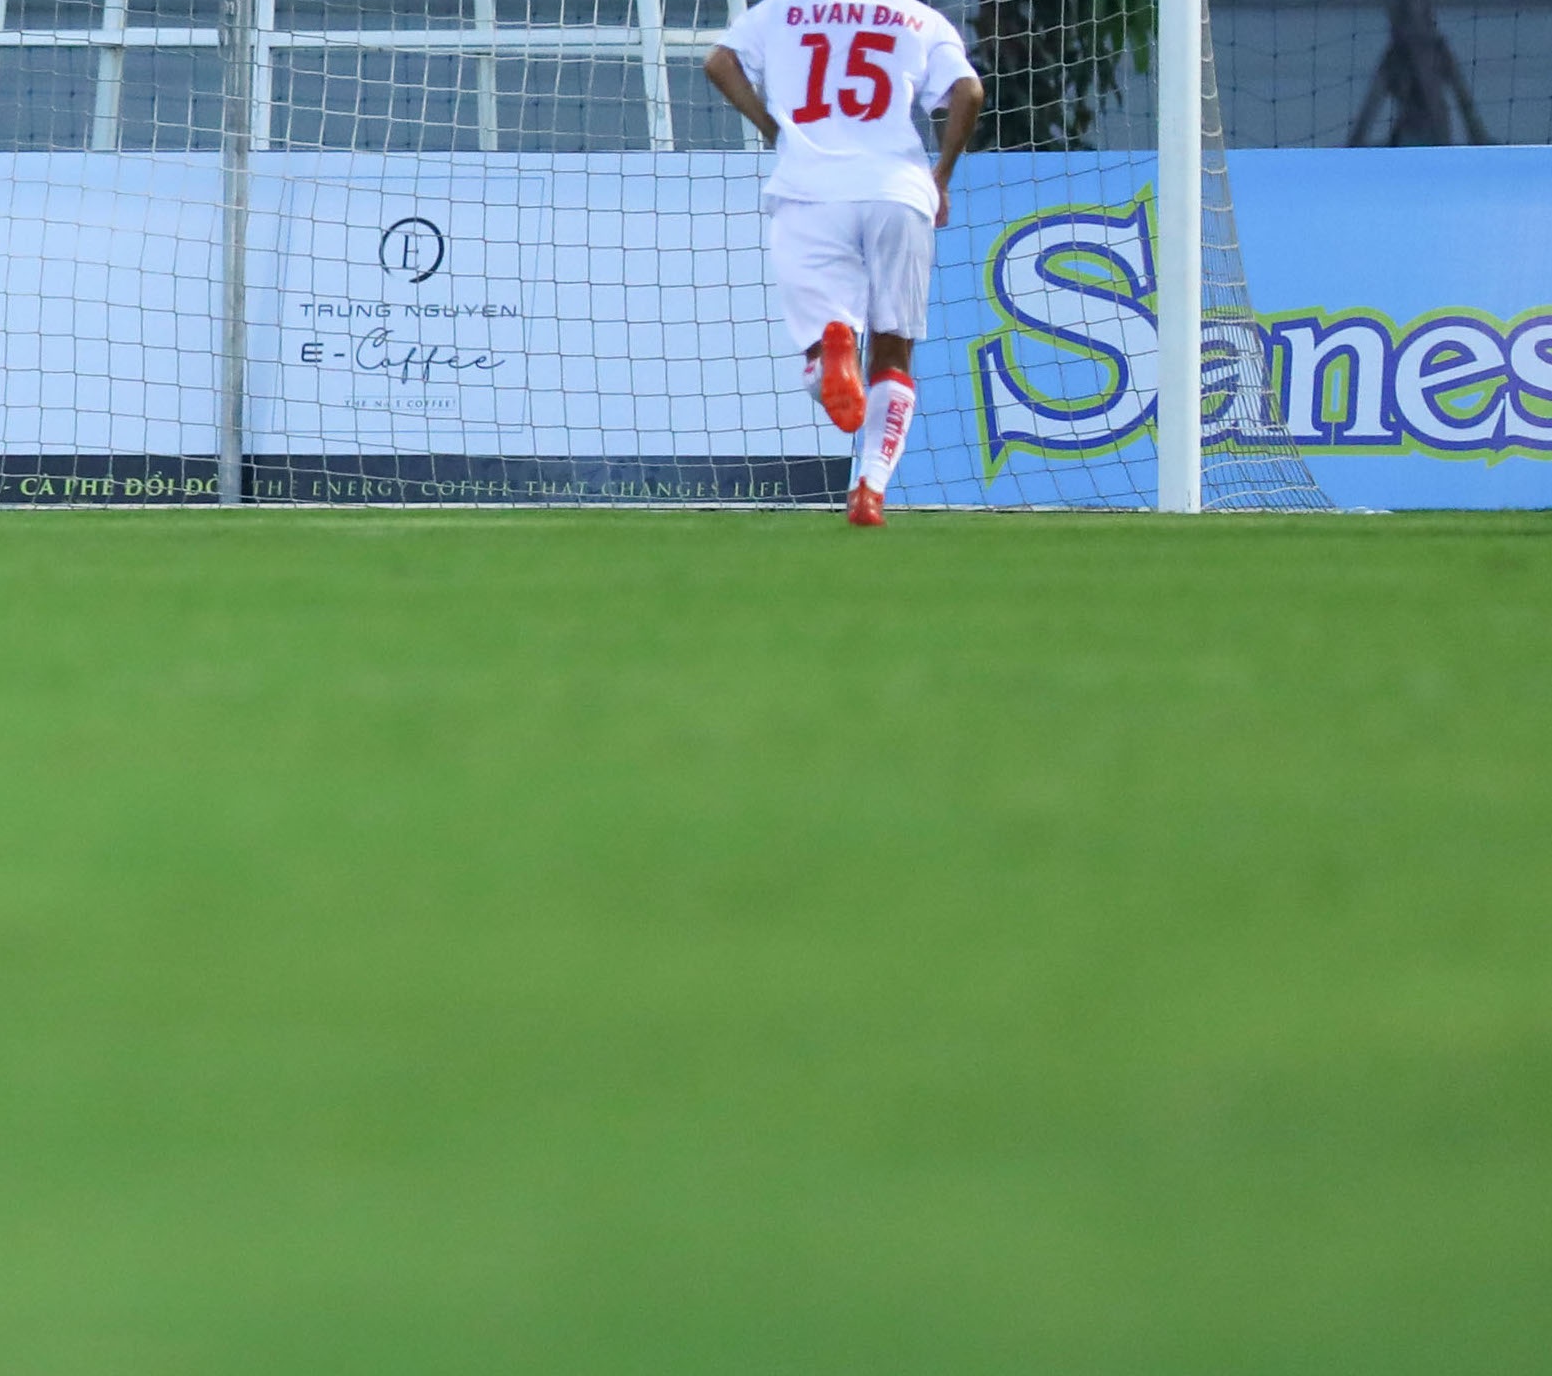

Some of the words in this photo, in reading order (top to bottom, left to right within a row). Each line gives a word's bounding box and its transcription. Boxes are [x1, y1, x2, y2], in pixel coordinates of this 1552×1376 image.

[792, 31, 897, 124] 15
[300, 303, 392, 318] TRUNG
[312, 479, 408, 497] ENERGY
[421, 479, 511, 498] COFFEE
[525, 480, 589, 498] THAT
[600, 480, 720, 498] CHANGES
[733, 480, 784, 498] LIFE
